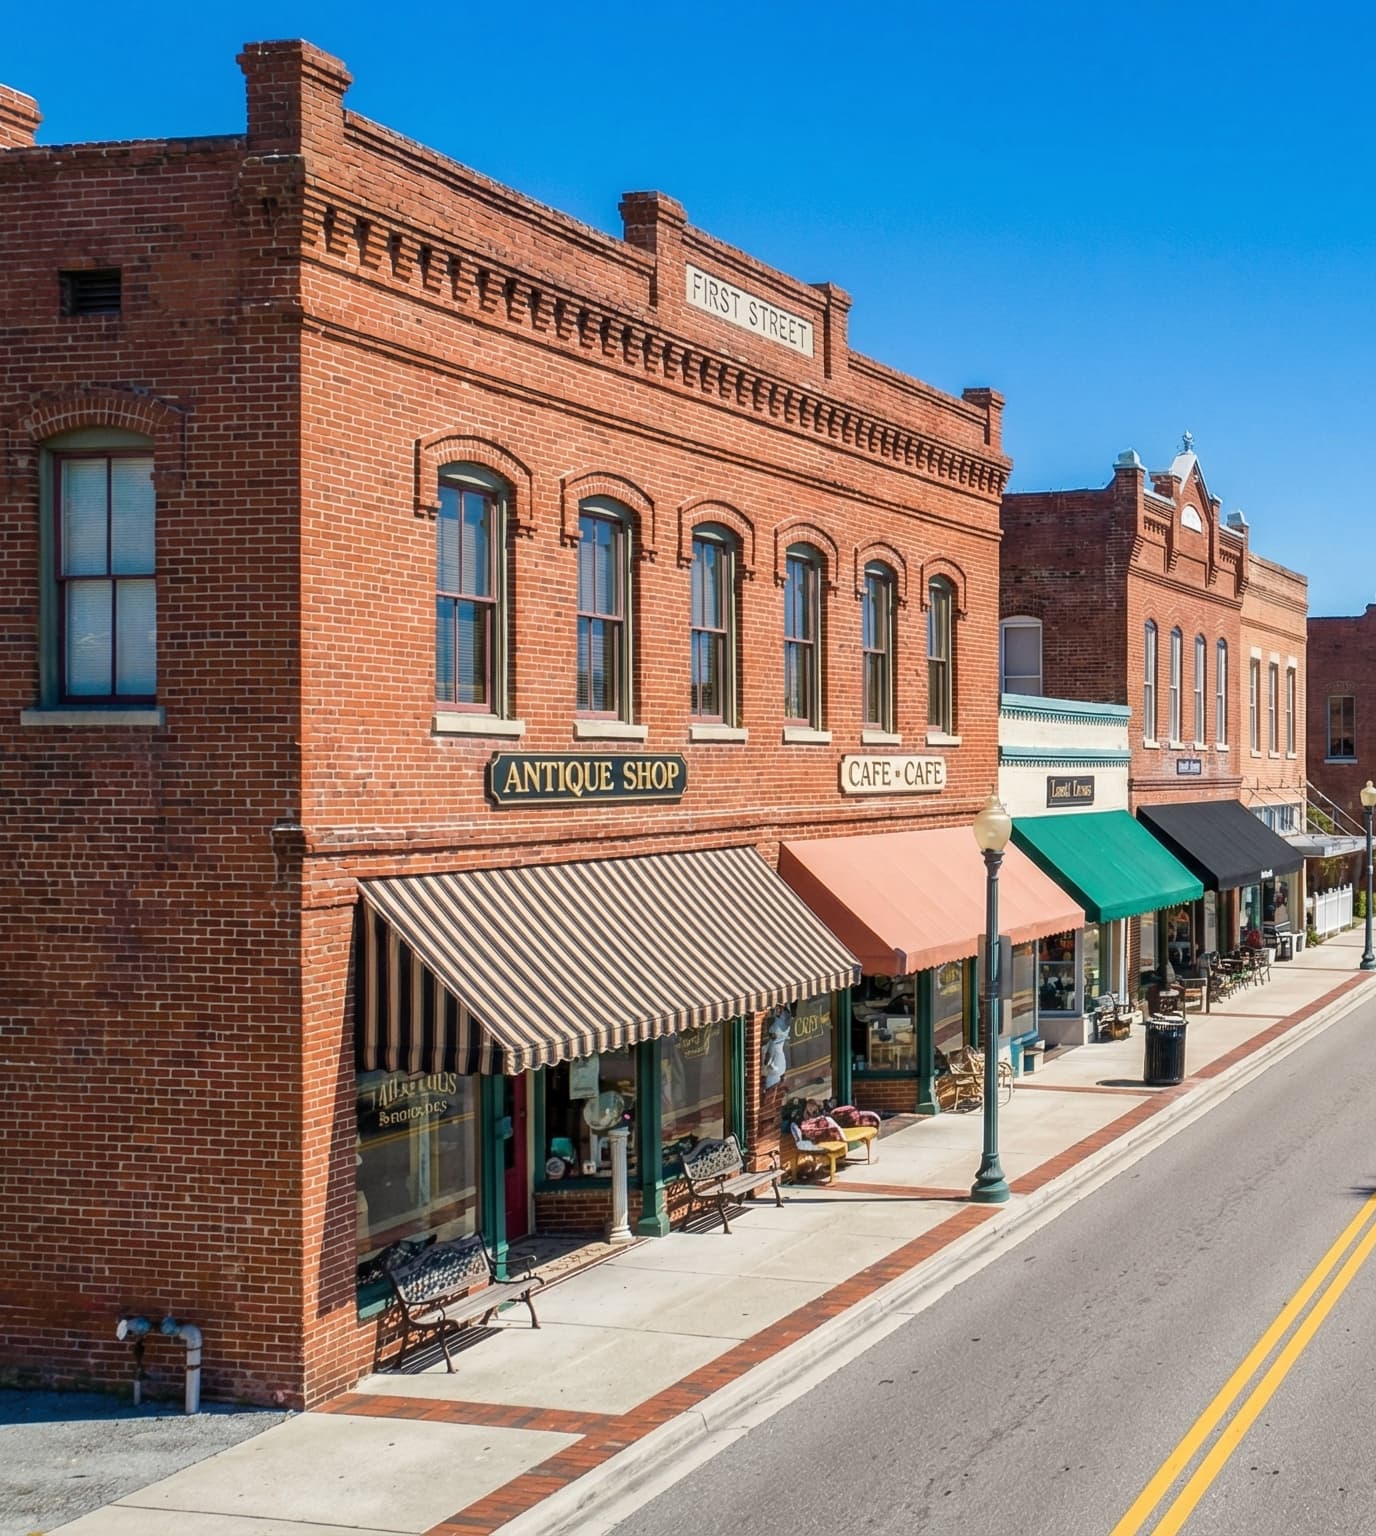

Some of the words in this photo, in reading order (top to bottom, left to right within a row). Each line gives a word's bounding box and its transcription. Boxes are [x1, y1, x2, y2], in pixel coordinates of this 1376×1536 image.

[693, 273, 741, 319] FIRST
[749, 301, 807, 349] STREET
[503, 761, 615, 797] ANTIQUE
[623, 761, 680, 790] SHOP
[848, 760, 892, 787] CAFE
[904, 761, 943, 785] CAFE
